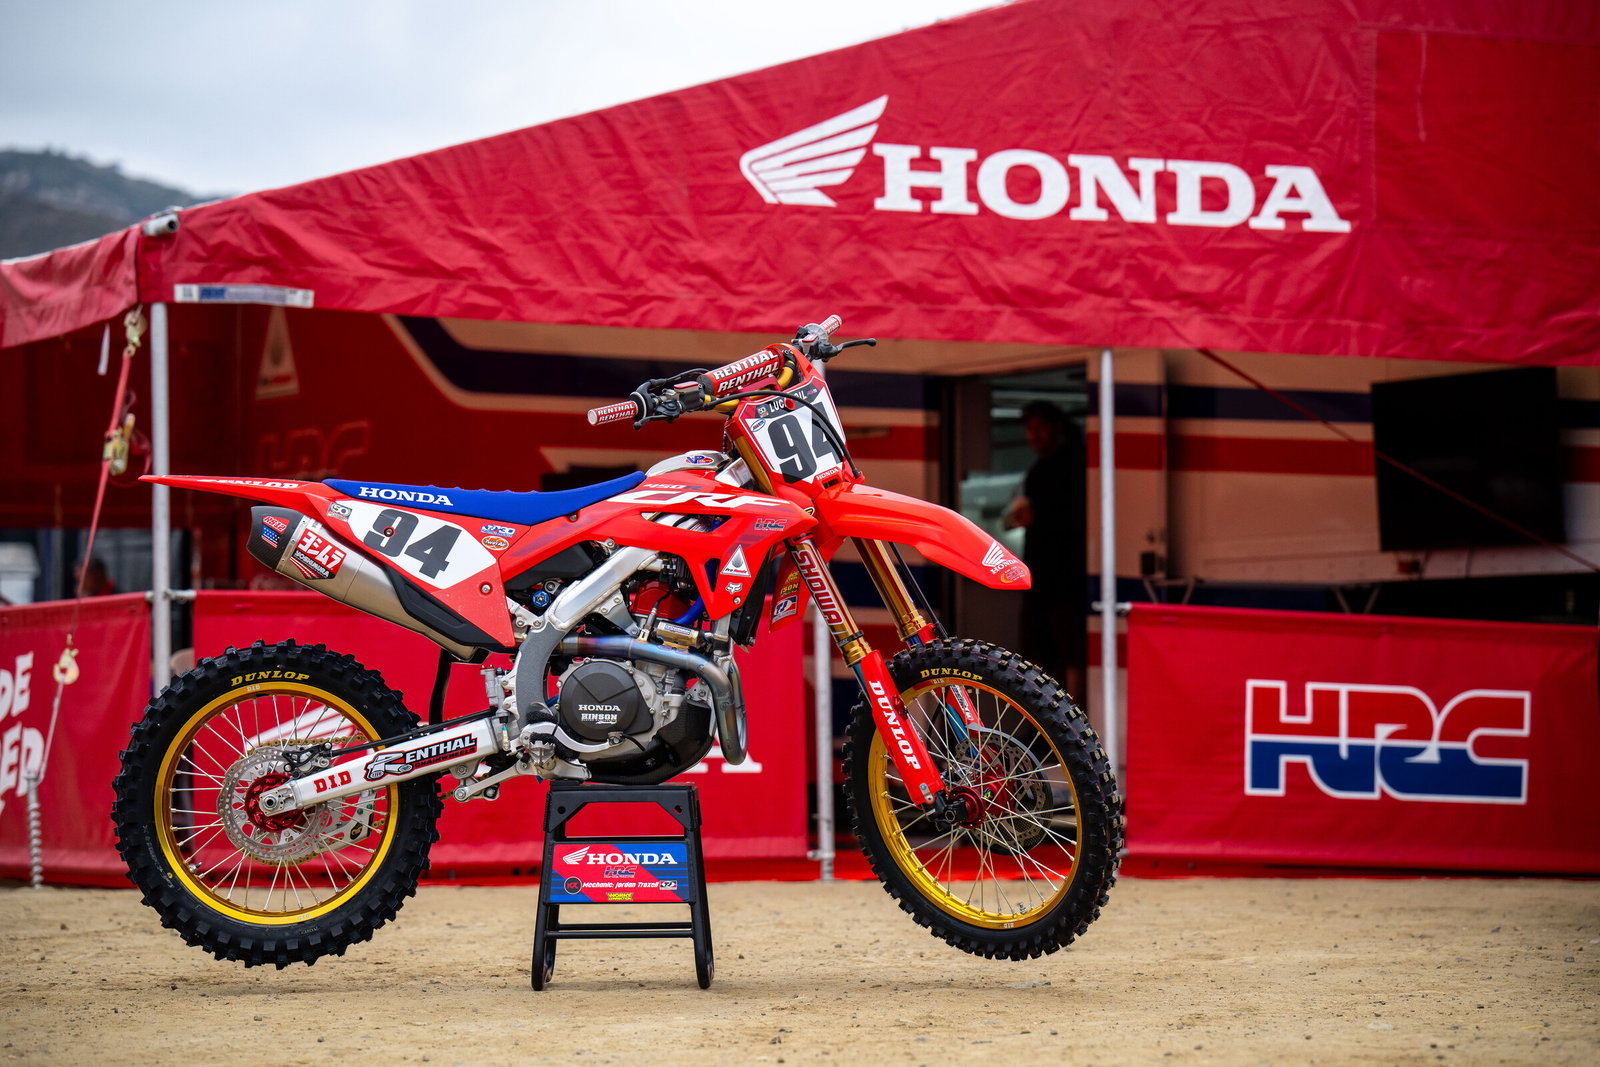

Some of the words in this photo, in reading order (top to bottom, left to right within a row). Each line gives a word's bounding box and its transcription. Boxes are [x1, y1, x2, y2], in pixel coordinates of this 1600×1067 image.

[872, 142, 1352, 234] HONDA
[711, 350, 779, 380] RENTHAL
[717, 361, 779, 393] RENTHAL
[597, 403, 635, 415] RENTHAL
[598, 410, 636, 422] RENTHAL
[767, 402, 844, 484] 94
[816, 468, 839, 480] HONDA
[358, 486, 454, 506] HONDA
[606, 490, 791, 508] CRF
[297, 531, 345, 569] ヨシムラ
[363, 508, 463, 580] 94
[293, 550, 331, 578] YOSHIMURA
[793, 549, 844, 626] SHOWA
[230, 670, 311, 687] DUNLOP
[920, 667, 984, 681] DUNLOP
[578, 704, 622, 712] HONDA
[581, 713, 618, 721] HINSON
[868, 680, 921, 770] DUNLOP
[1244, 679, 1532, 805] HRC
[313, 770, 352, 793] D.I.D
[586, 853, 678, 865] HONDA
[603, 865, 638, 876] HRC
